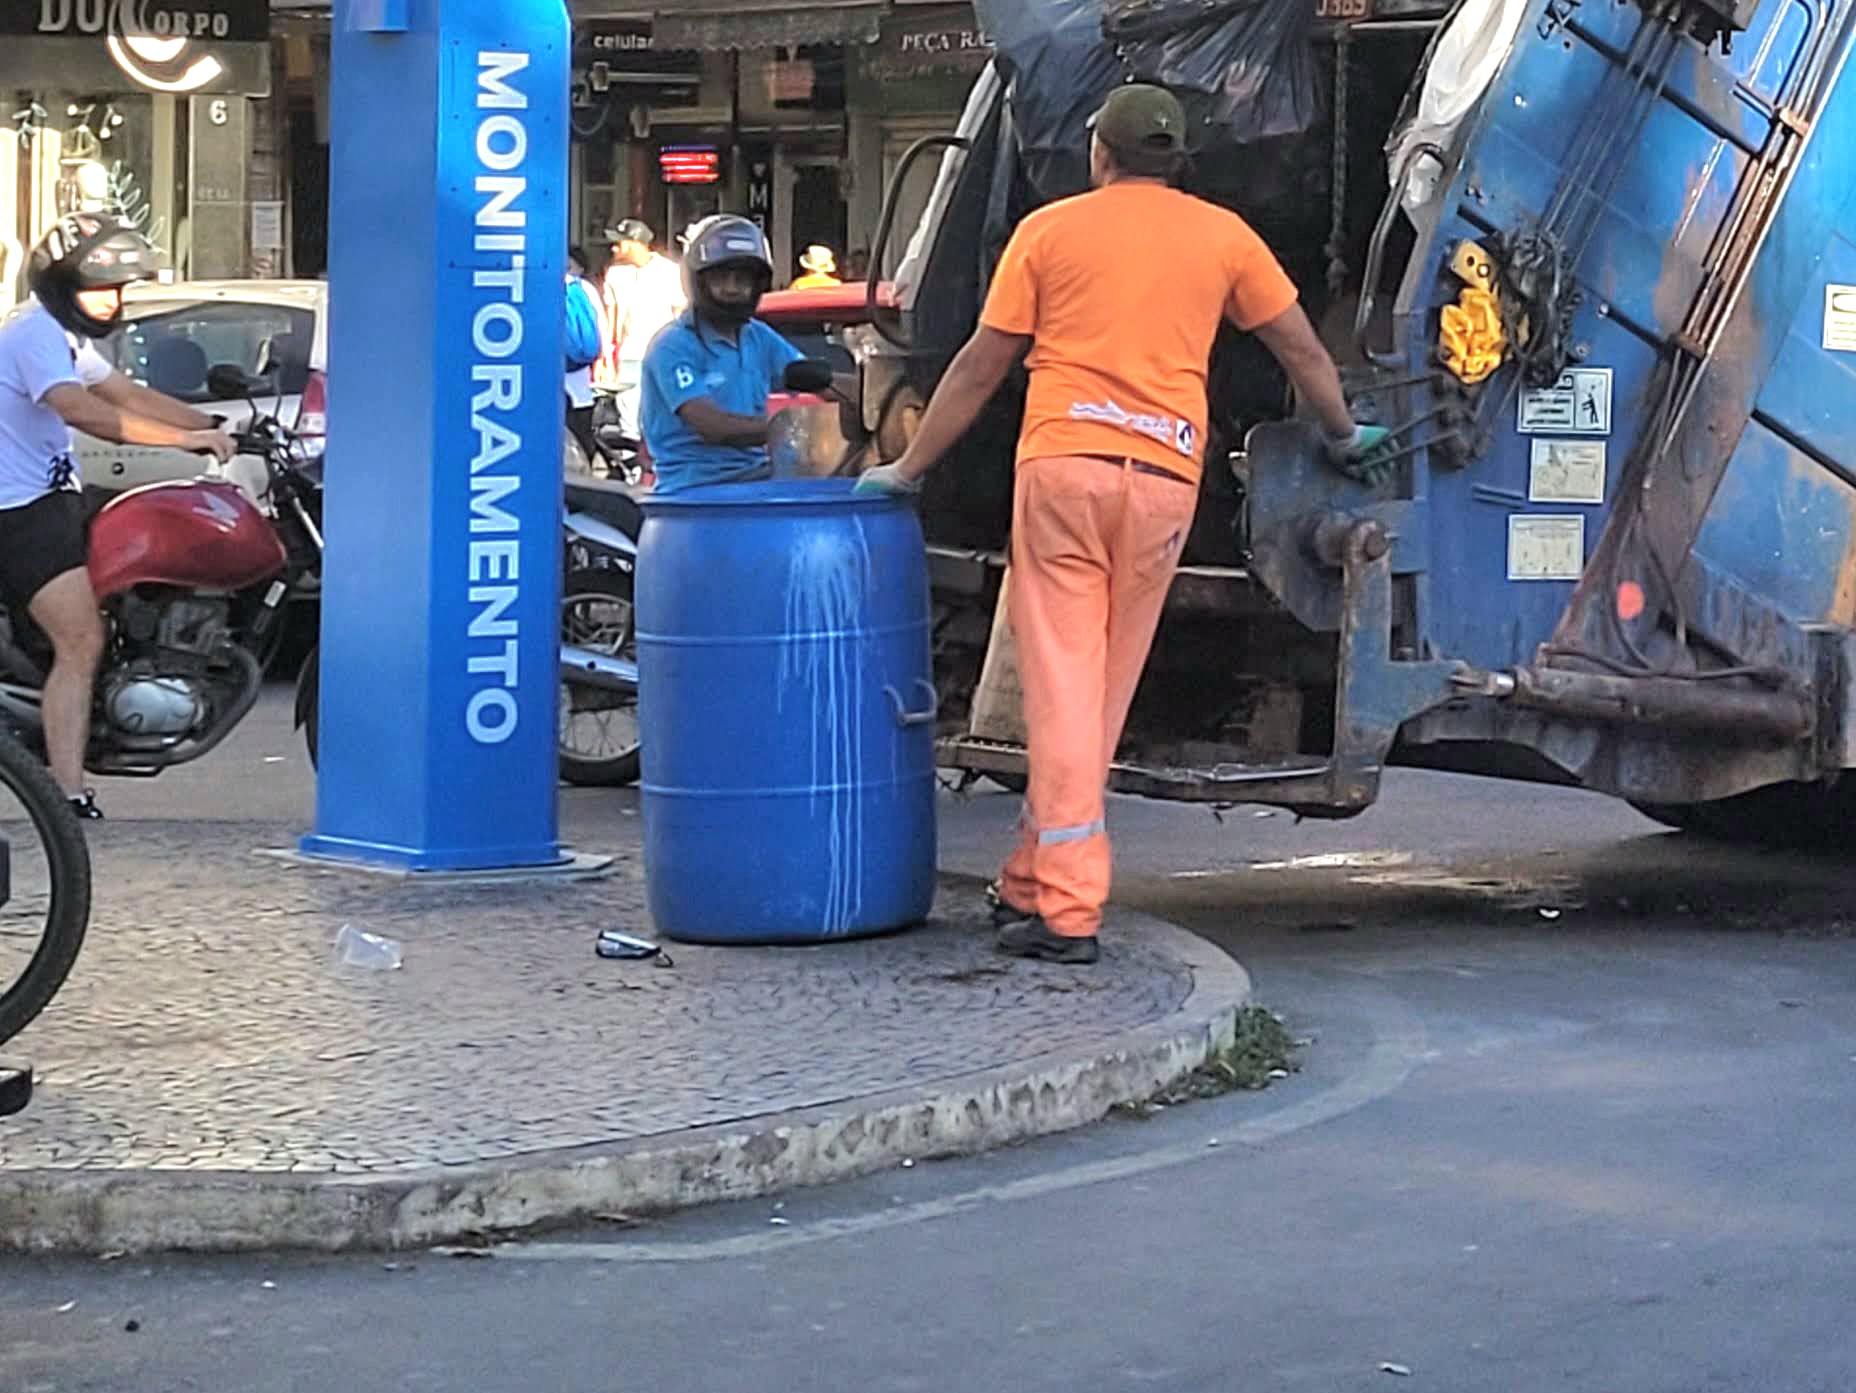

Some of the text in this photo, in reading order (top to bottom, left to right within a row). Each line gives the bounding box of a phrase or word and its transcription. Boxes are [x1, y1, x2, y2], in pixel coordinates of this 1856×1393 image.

[902, 33, 950, 54] PEÇA
[209, 99, 228, 125] 6
[466, 50, 530, 746] MONITORAMENTO
